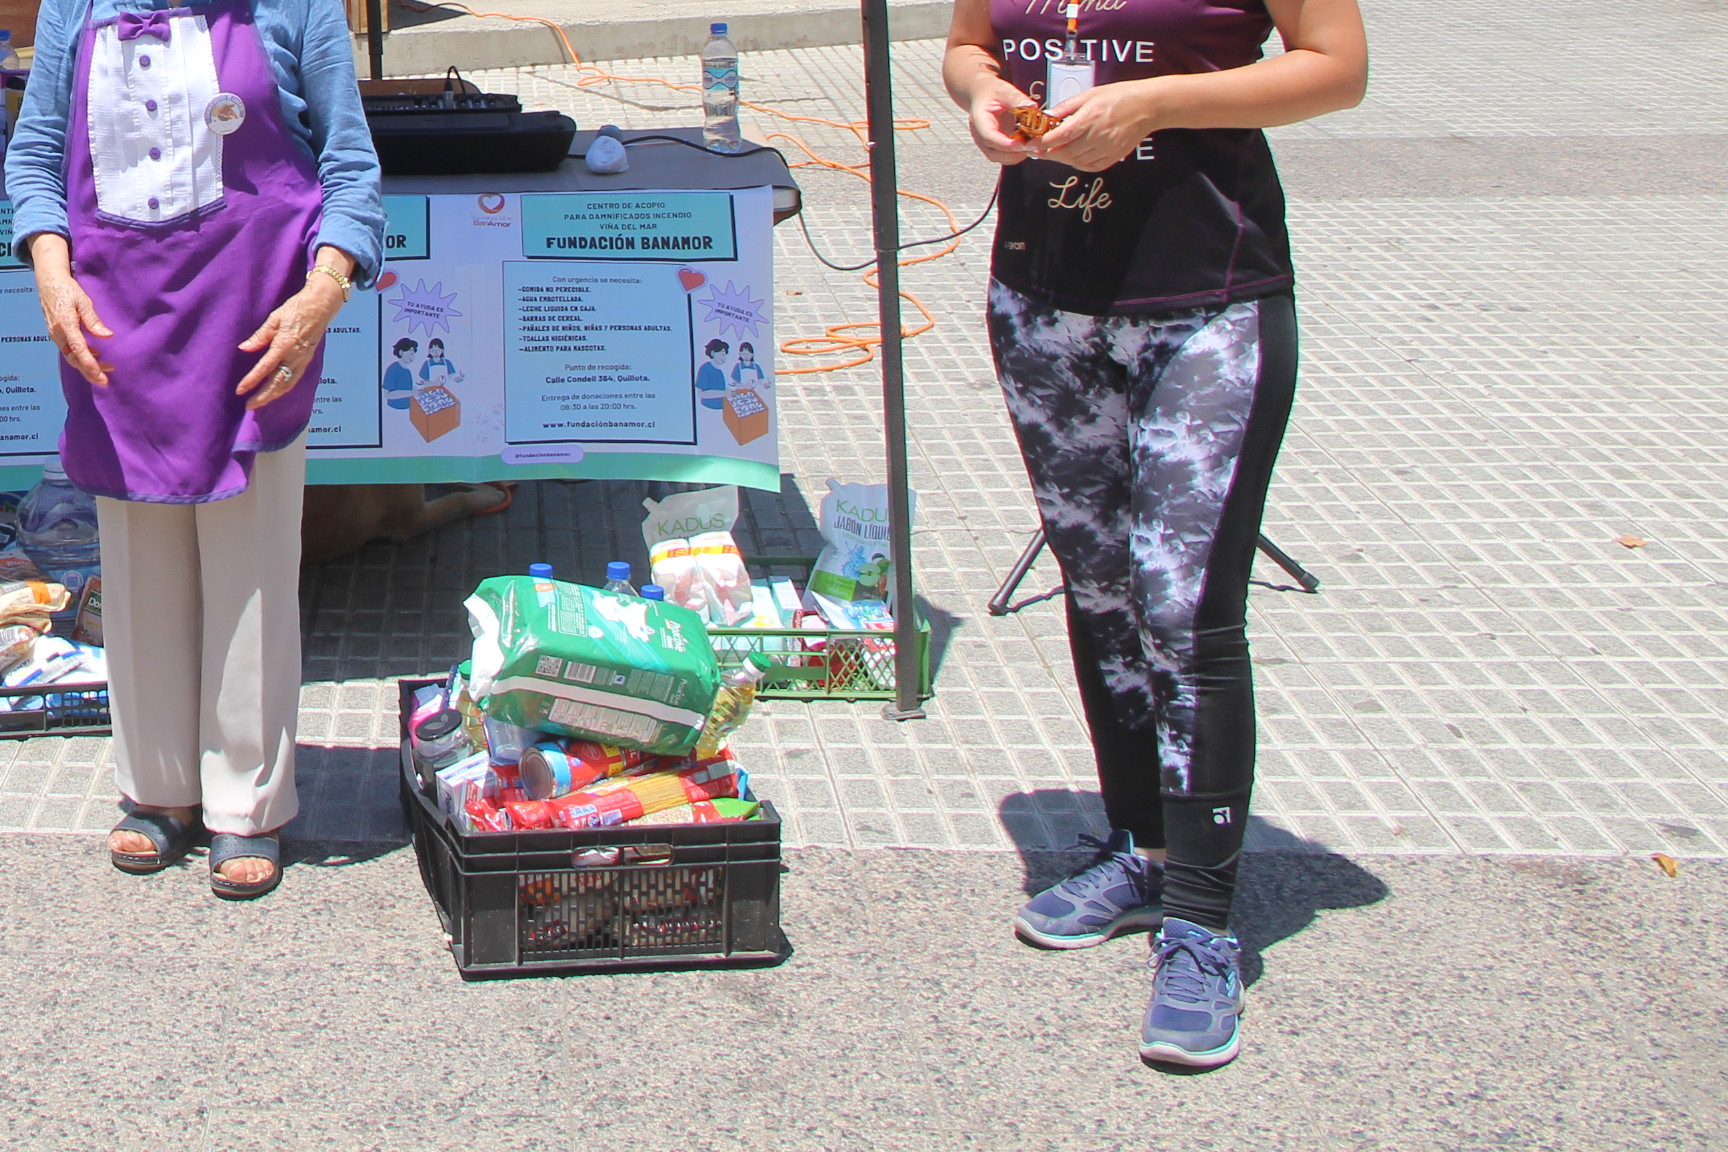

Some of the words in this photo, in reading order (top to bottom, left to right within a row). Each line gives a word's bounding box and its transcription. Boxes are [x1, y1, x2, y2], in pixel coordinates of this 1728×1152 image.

[1048, 176, 1112, 222] Life
[546, 234, 635, 250] FUNDACIÓN
[641, 236, 713, 250] BANAMOR
[6, 386, 36, 394] Quillota.
[836, 499, 889, 522] KADU
[657, 513, 725, 536] KADUS
